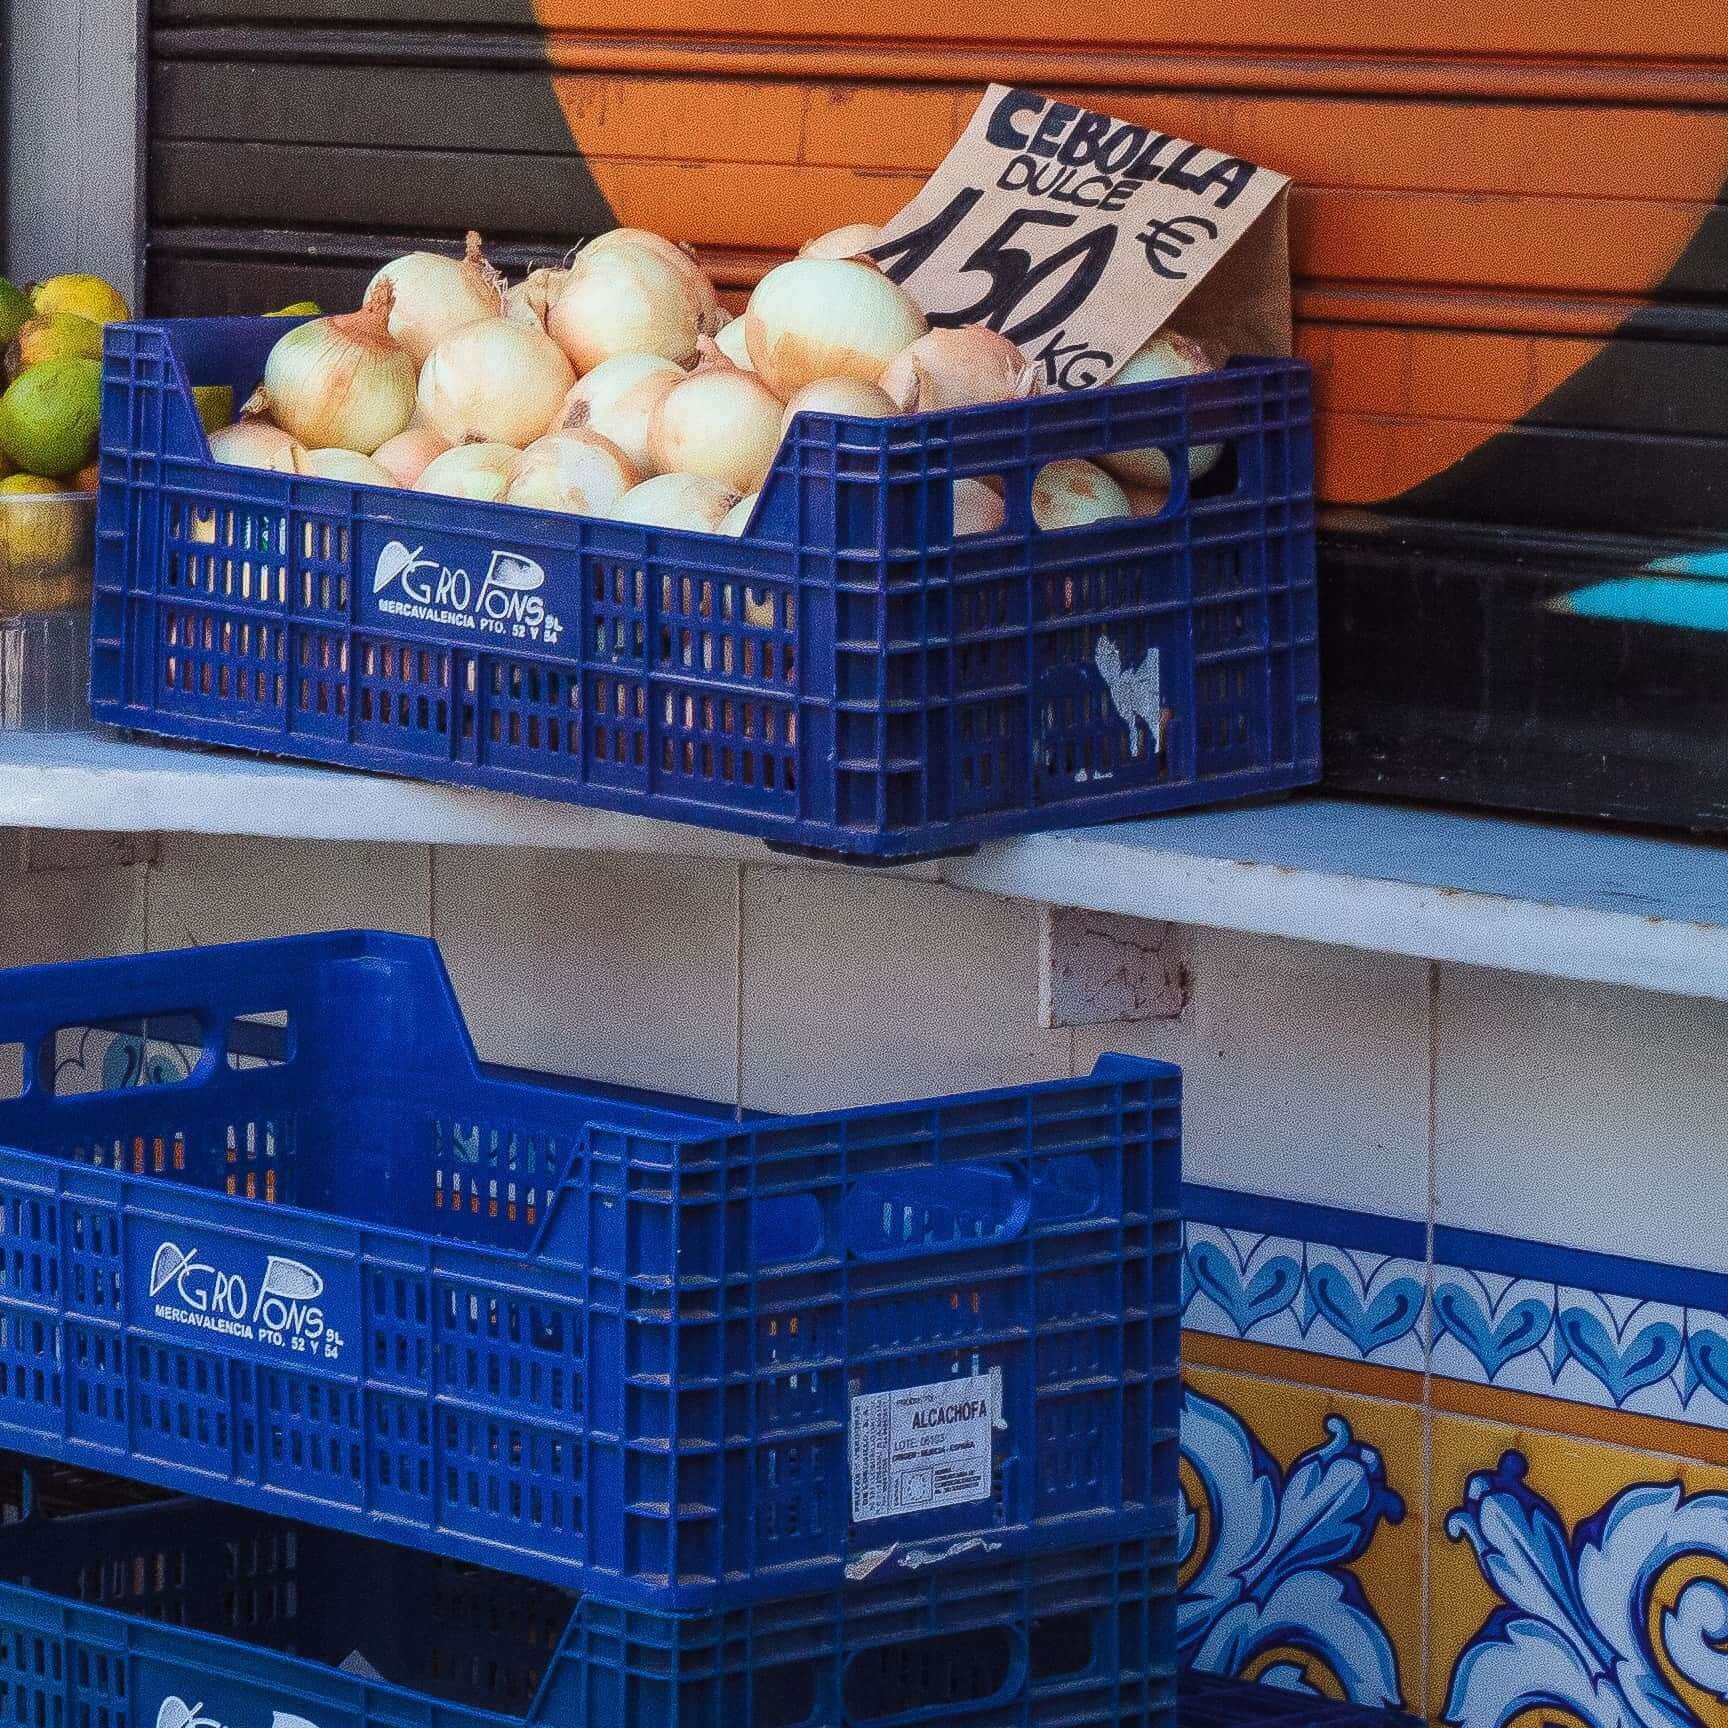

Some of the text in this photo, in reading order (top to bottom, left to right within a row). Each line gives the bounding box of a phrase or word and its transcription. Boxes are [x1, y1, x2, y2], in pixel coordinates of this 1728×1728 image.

[986, 89, 1257, 210] CEBOLLA
[996, 154, 1145, 212] DULCE
[1136, 215, 1219, 280] €
[1035, 330, 1114, 391] KG
[378, 598, 476, 629] MERCAVALENCIA
[480, 617, 507, 636] PTO.
[475, 550, 545, 627] PONS
[154, 1303, 255, 1340] MERCAVALENCIA
[258, 1327, 286, 1349] PTO.
[242, 1255, 325, 1339] PONS
[911, 1399, 988, 1430] ALCACHOFA
